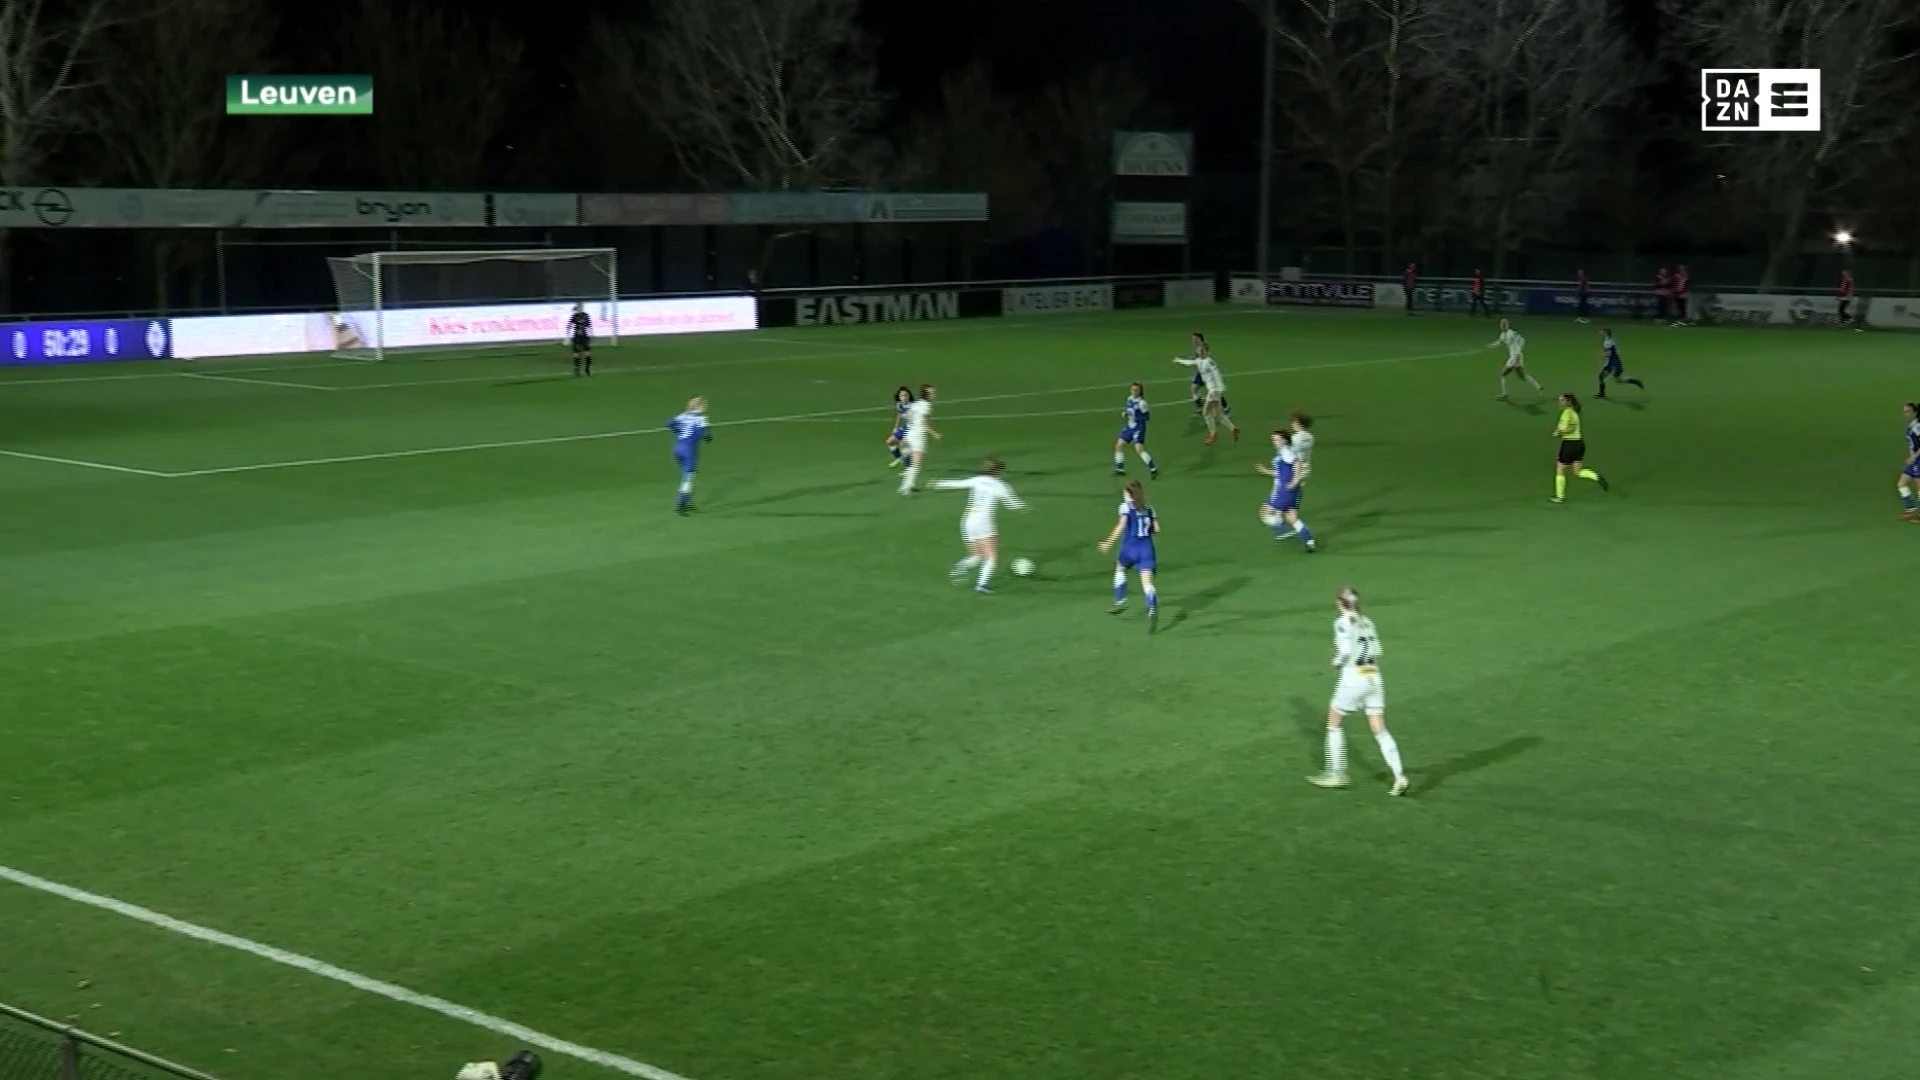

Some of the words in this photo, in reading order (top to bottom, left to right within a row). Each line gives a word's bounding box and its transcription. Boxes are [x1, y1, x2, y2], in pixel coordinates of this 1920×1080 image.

[796, 292, 958, 325] EASTMAN
[428, 316, 469, 335] Kies
[471, 315, 560, 333] rendement
[41, 328, 92, 357] 50:29
